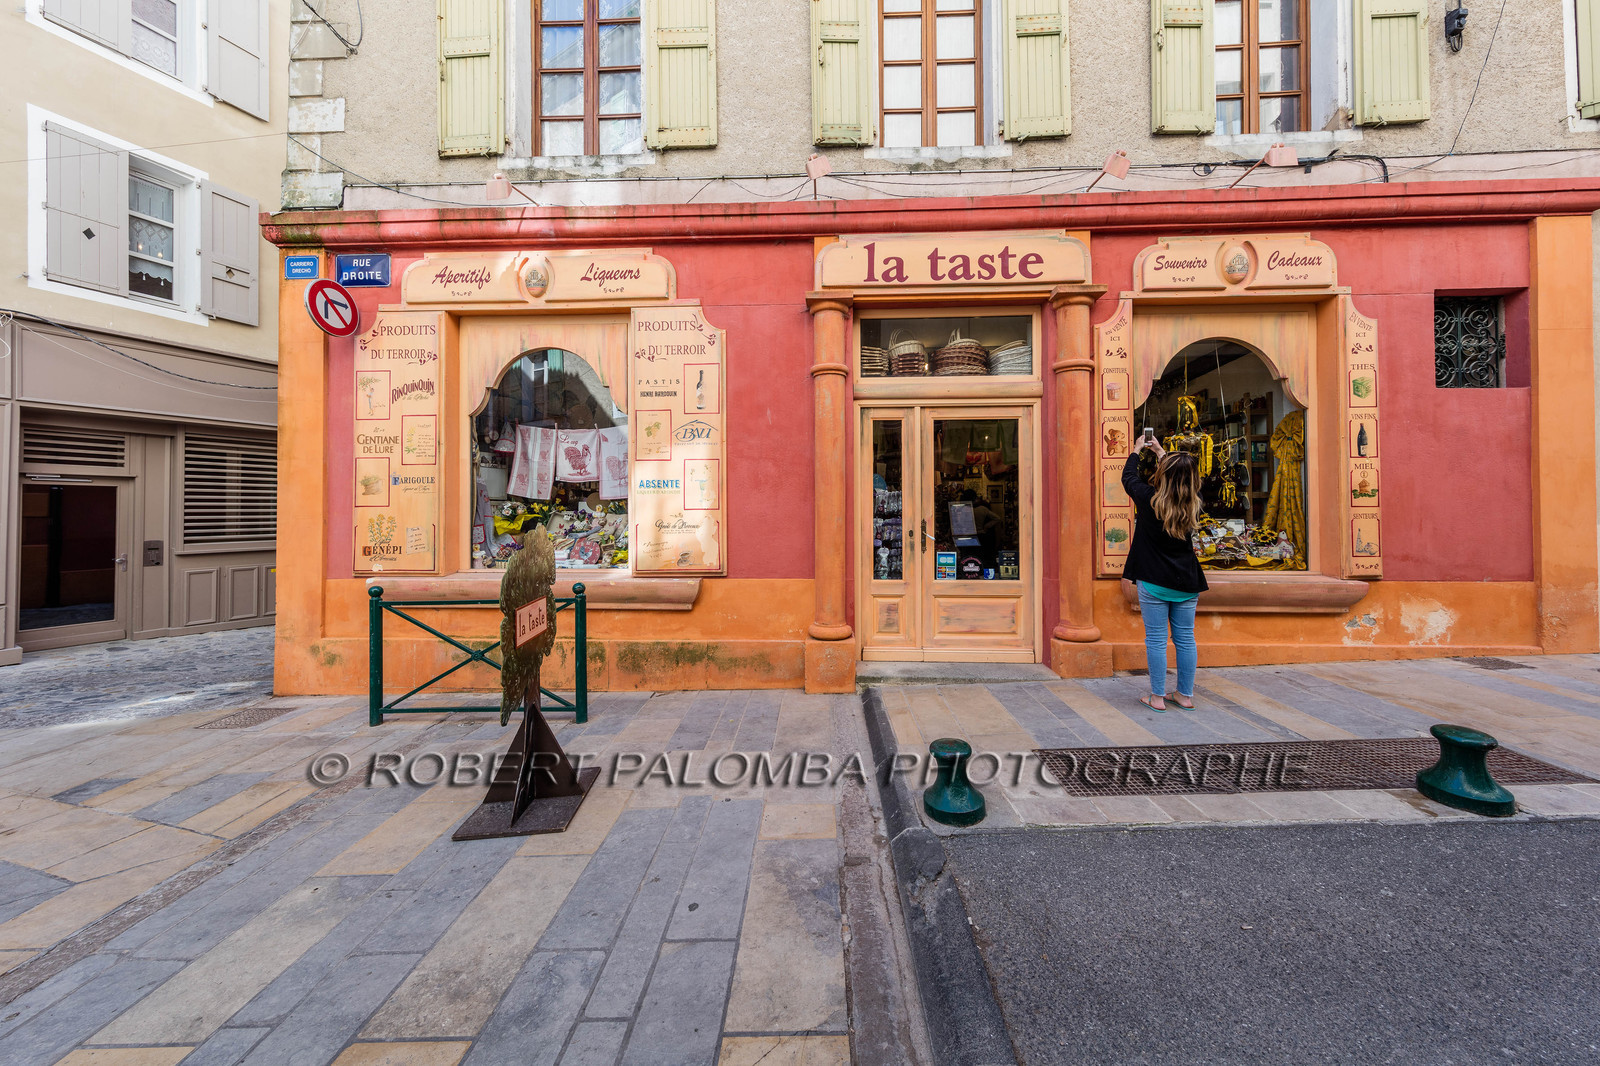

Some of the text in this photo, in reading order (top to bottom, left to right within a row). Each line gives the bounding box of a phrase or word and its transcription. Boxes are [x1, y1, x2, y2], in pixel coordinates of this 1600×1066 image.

[352, 258, 371, 267] RUE
[863, 242, 1044, 283] la taste
[1154, 255, 1208, 271] Souvenirs
[1267, 250, 1322, 271] Cadeaux
[342, 271, 382, 281] DROITE
[432, 266, 491, 289] Aperitifs
[580, 262, 641, 287] Liqueurs
[637, 320, 697, 332] PRODUITS
[1111, 316, 1128, 333] VENTE
[1356, 316, 1373, 332] VENTE
[380, 325, 436, 336] PRODUITS
[371, 349, 426, 360] DU TERROIR
[648, 345, 706, 356] DU TERROIR
[1351, 363, 1376, 371] THES
[1103, 415, 1128, 423] CADEAUX
[356, 434, 400, 445] GENTIANE
[363, 445, 394, 454] DE LURE
[391, 476, 436, 486] FARIGOULE
[638, 479, 680, 488] ABSENTE
[1104, 512, 1129, 520] LAVANDE
[362, 542, 402, 556] GÉNÉPI
[519, 607, 545, 637] la taste
